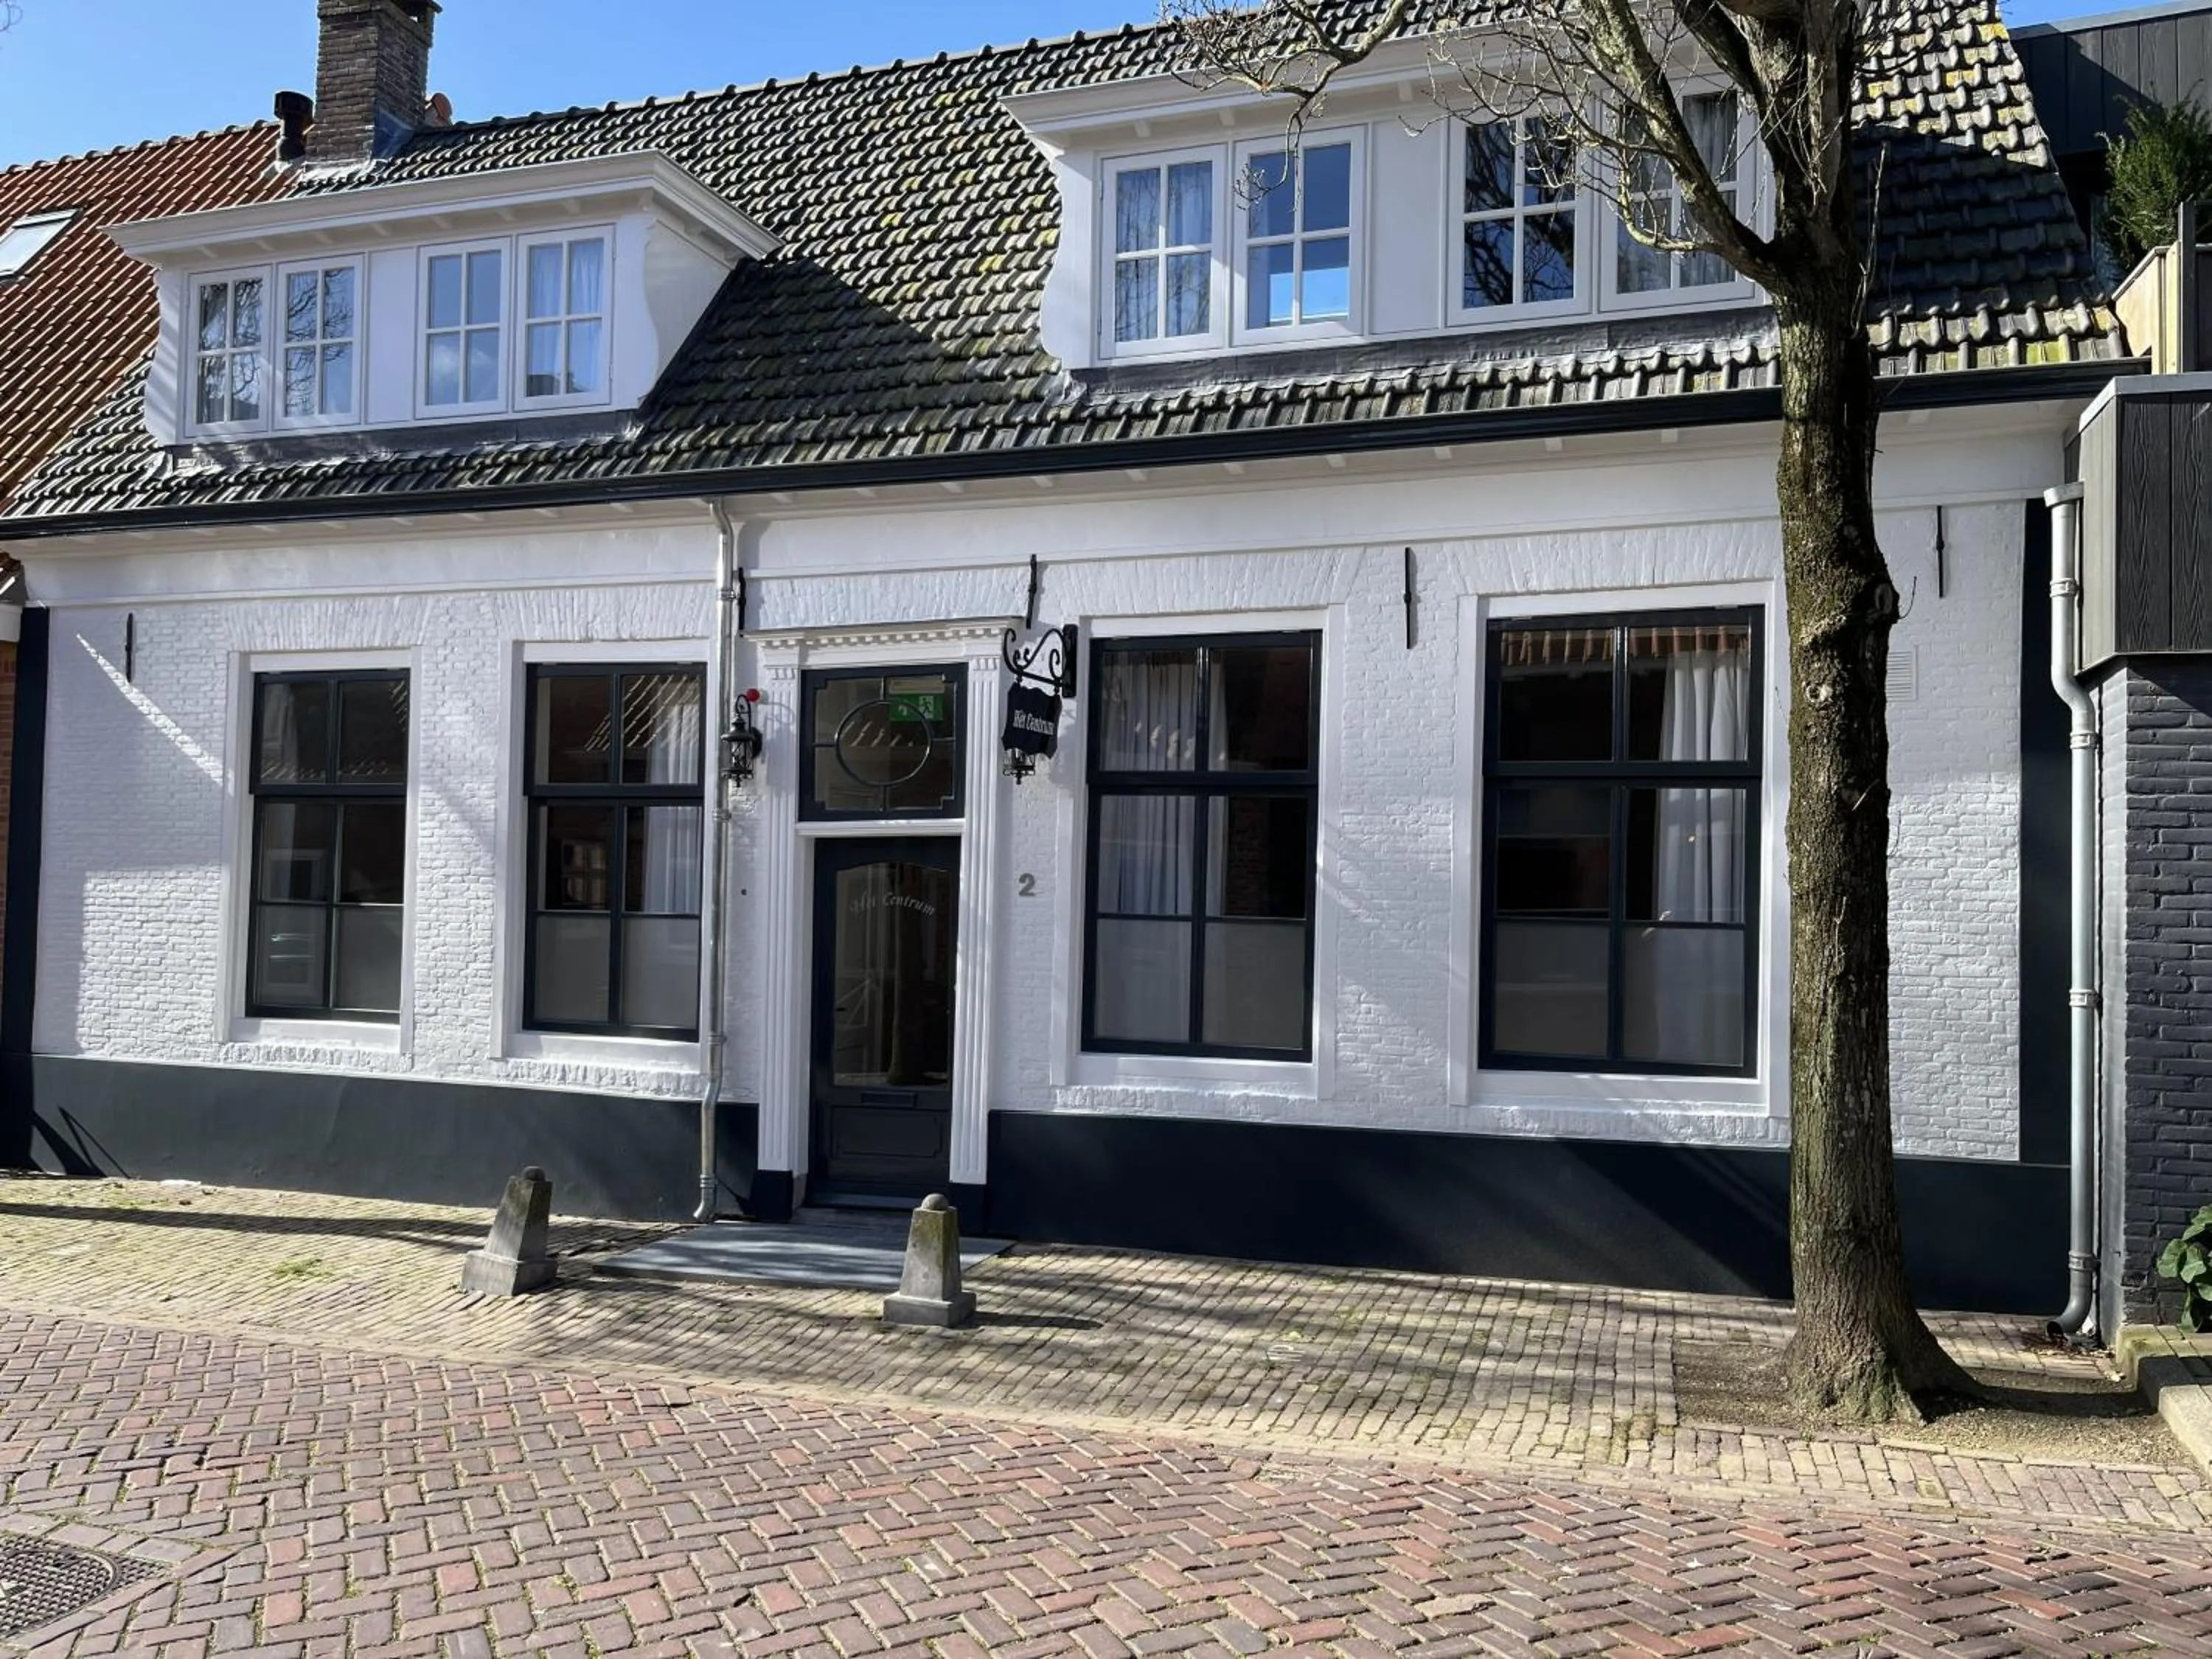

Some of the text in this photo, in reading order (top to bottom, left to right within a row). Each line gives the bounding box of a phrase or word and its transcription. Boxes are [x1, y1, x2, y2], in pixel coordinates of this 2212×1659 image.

[1026, 712, 1055, 735] Centrum
[1018, 872, 1036, 897] 2
[883, 891, 936, 917] Centrum
